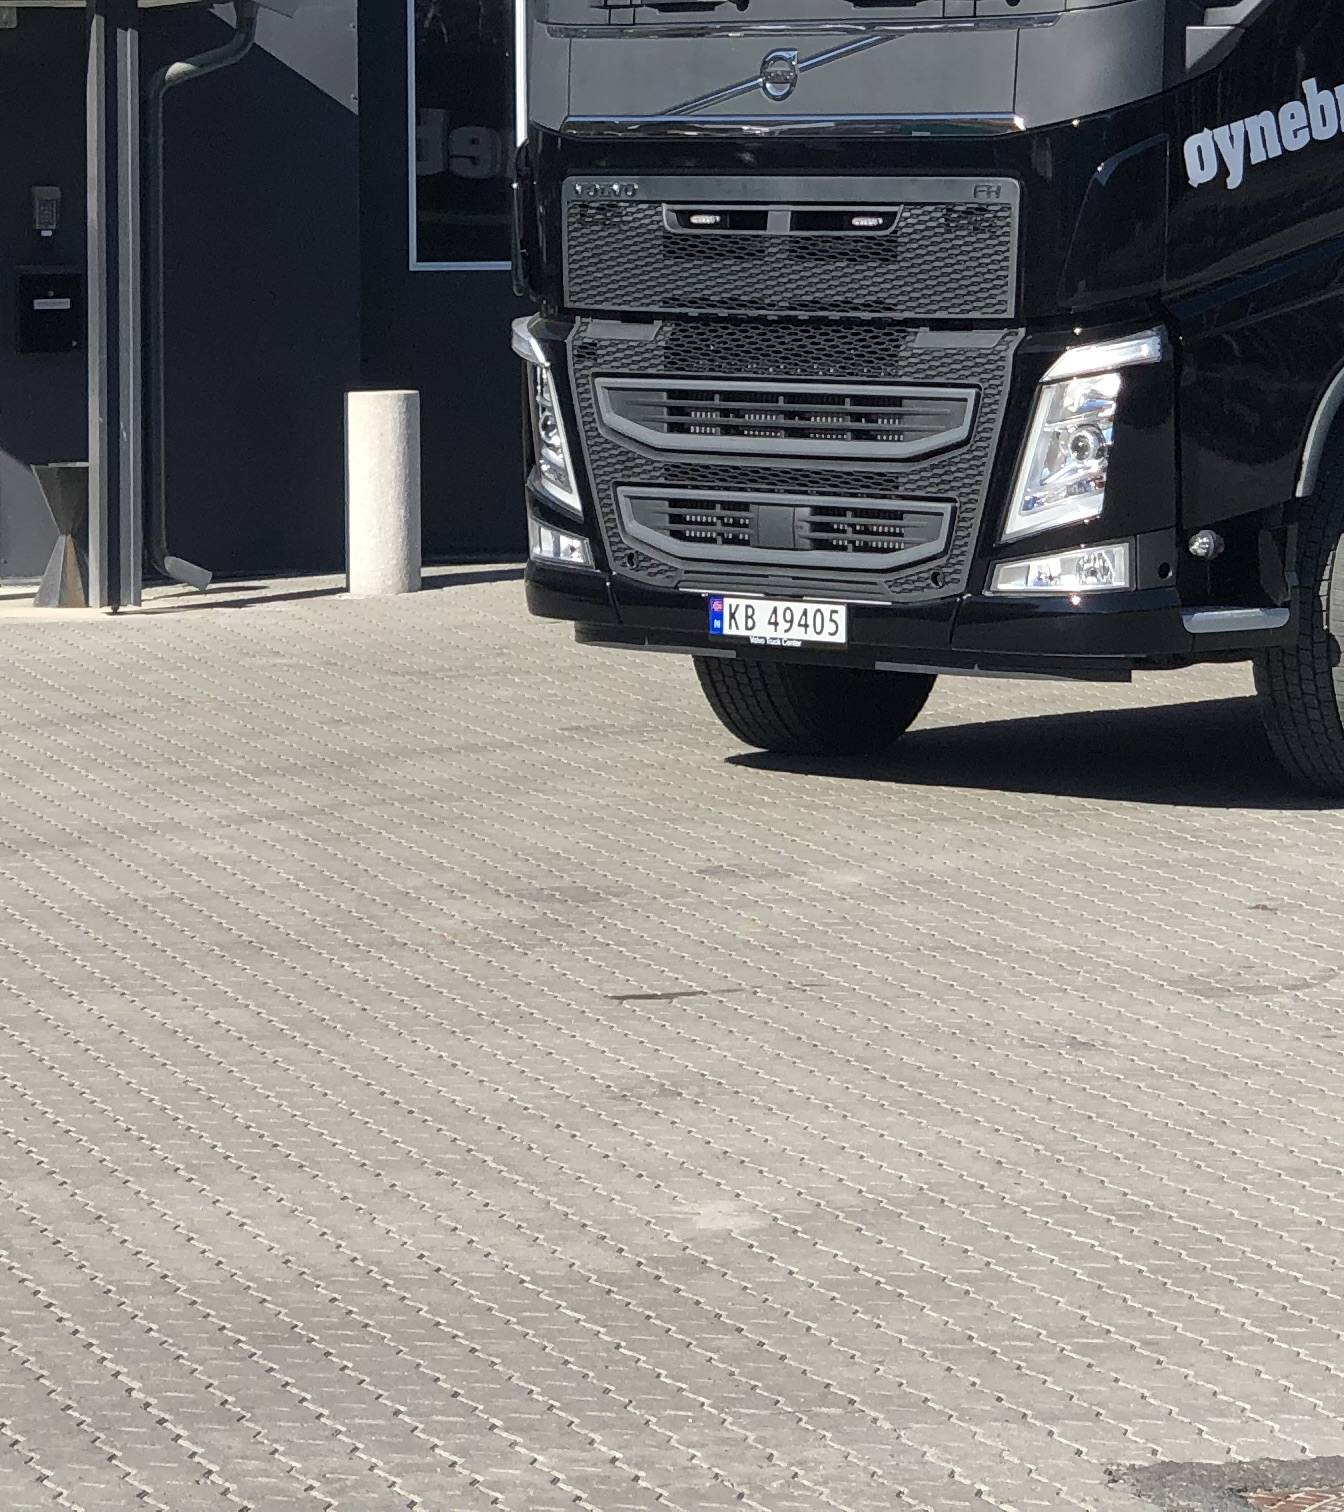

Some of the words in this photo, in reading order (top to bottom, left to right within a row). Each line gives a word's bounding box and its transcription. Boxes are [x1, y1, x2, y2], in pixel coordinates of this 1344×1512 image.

[973, 184, 1002, 199] FH
[728, 603, 756, 631] KB
[767, 605, 839, 636] 49405
